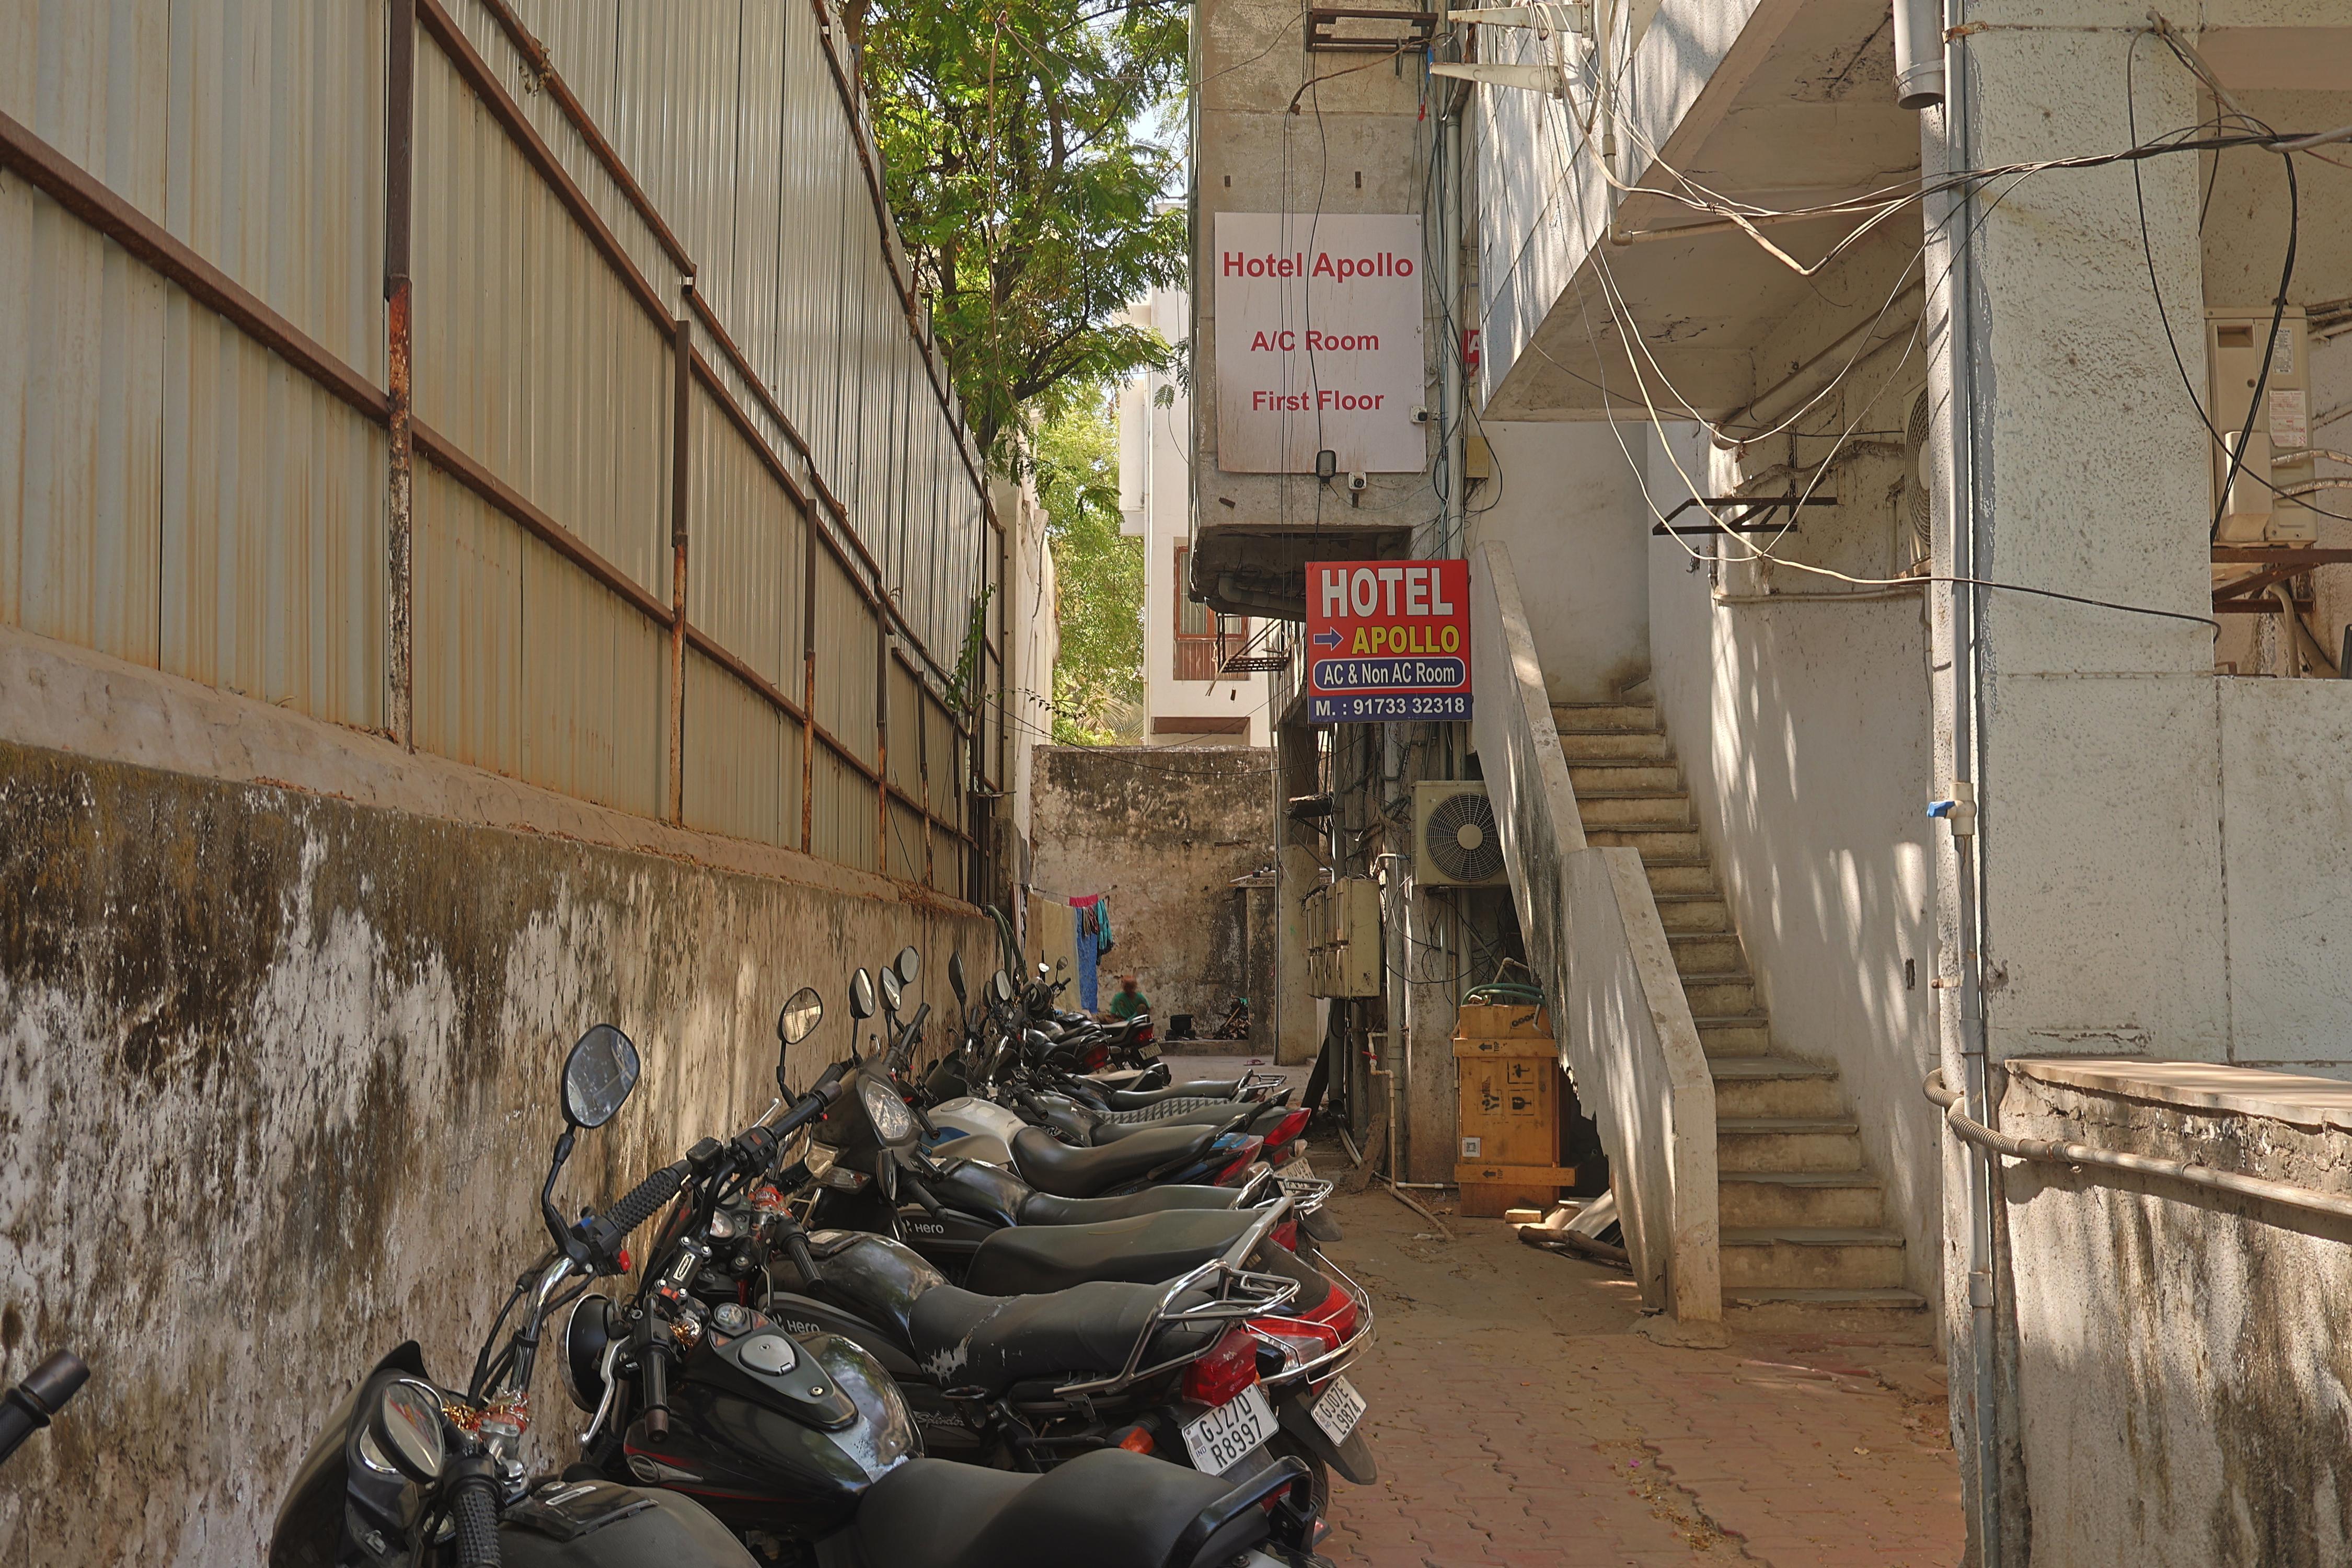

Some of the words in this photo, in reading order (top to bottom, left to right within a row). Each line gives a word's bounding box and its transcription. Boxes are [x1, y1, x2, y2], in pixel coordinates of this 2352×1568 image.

[1224, 251, 1302, 277] Hotel
[1312, 252, 1413, 283] Apollo
[1250, 330, 1296, 352] A/C
[1305, 330, 1379, 351] Room
[1252, 390, 1309, 411] First
[1318, 390, 1384, 411] Floor
[1321, 567, 1454, 618] HOTEL
[1351, 625, 1460, 654] APOLLO
[1323, 664, 1344, 685] AC
[1348, 663, 1358, 684] &
[1362, 663, 1389, 684] Non
[1392, 662, 1412, 684] AC
[1416, 662, 1455, 683] Room
[1353, 698, 1406, 715] 91733
[1412, 697, 1465, 713] 32318
[914, 1223, 944, 1233] Hero
[1319, 1382, 1348, 1418] GJ07E
[1199, 1392, 1252, 1443] GJ27D
[1332, 1397, 1362, 1435] L9874
[1195, 1445, 1207, 1458] IND
[1210, 1413, 1262, 1468] R8997
